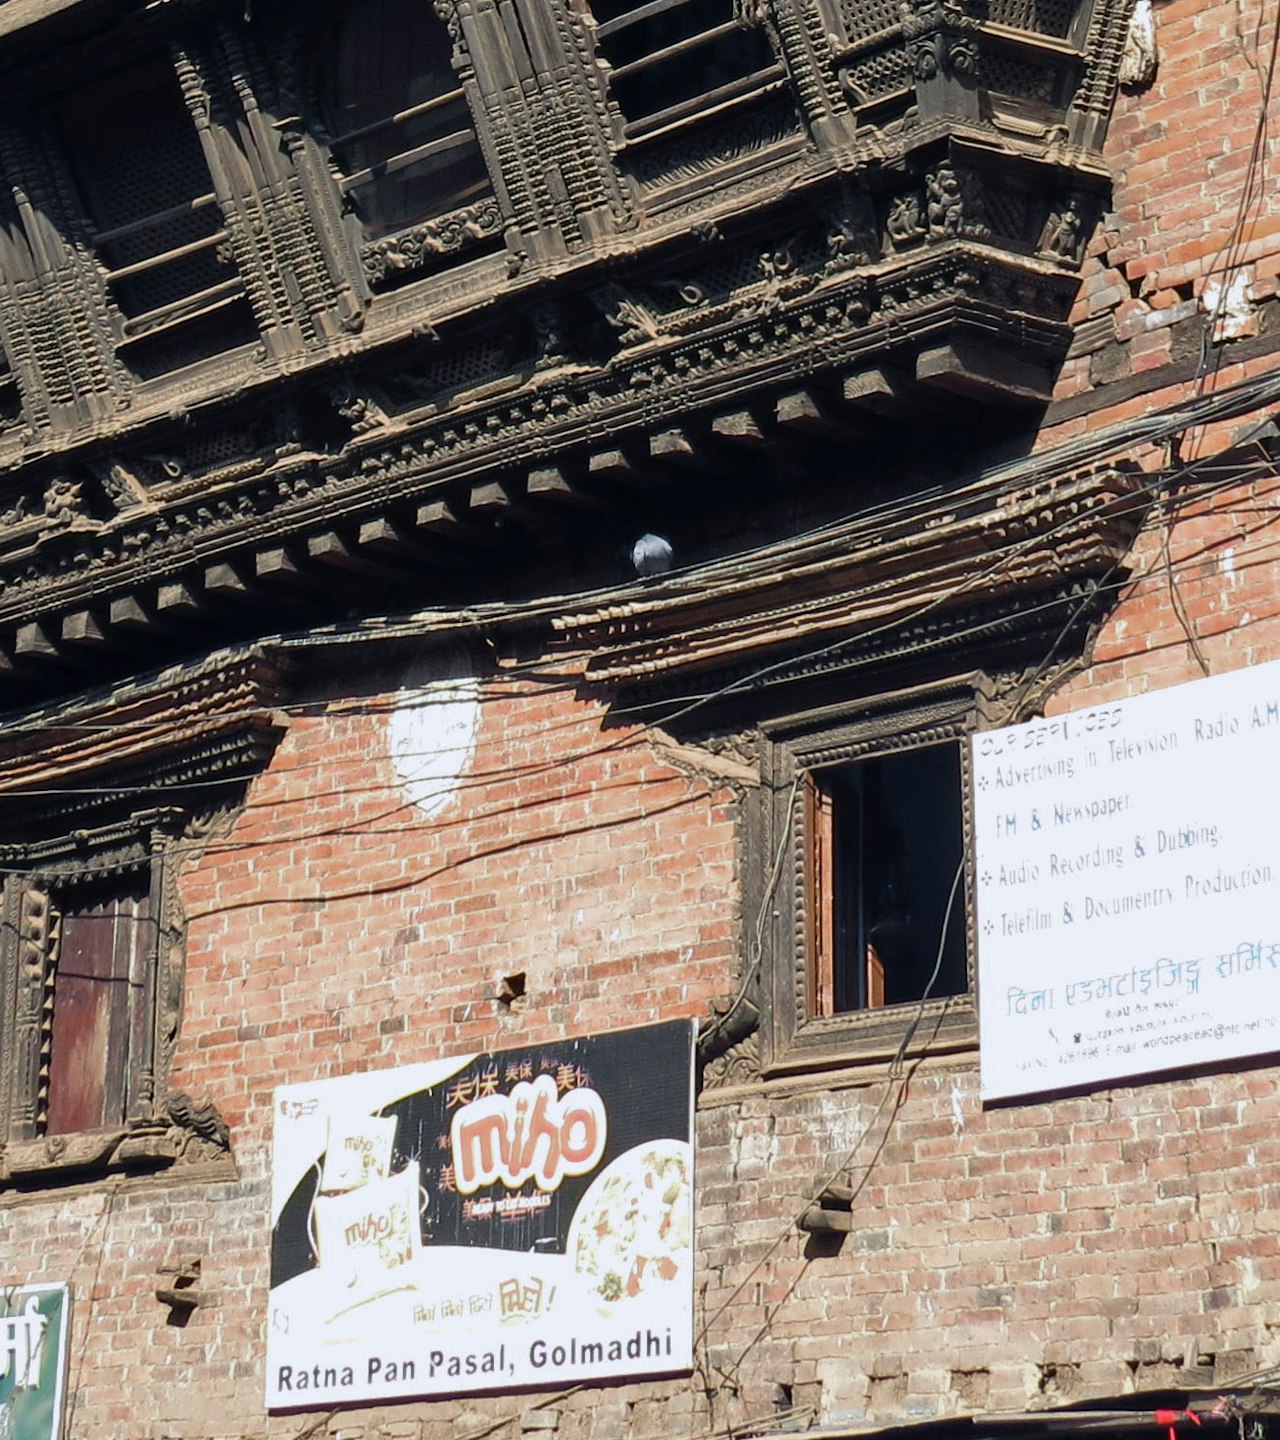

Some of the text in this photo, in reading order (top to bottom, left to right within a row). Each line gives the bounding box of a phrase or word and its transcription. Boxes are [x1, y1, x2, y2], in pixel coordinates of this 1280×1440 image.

[995, 756, 1074, 790] Advertising
[1084, 747, 1097, 767] in
[1108, 731, 1178, 763] Television
[1194, 713, 1239, 742] Radio
[996, 813, 1017, 838] FM
[1031, 808, 1042, 831] &
[998, 862, 1040, 888] Audio
[1050, 844, 1123, 879] Recording
[1134, 835, 1145, 858] &
[1001, 909, 1052, 937] Telefilm
[1062, 900, 1073, 924] &
[1084, 886, 1173, 921] Documentry
[458, 1085, 598, 1184] miho
[277, 1327, 672, 1392] Ratna Pan Pasal, Golmadhi
